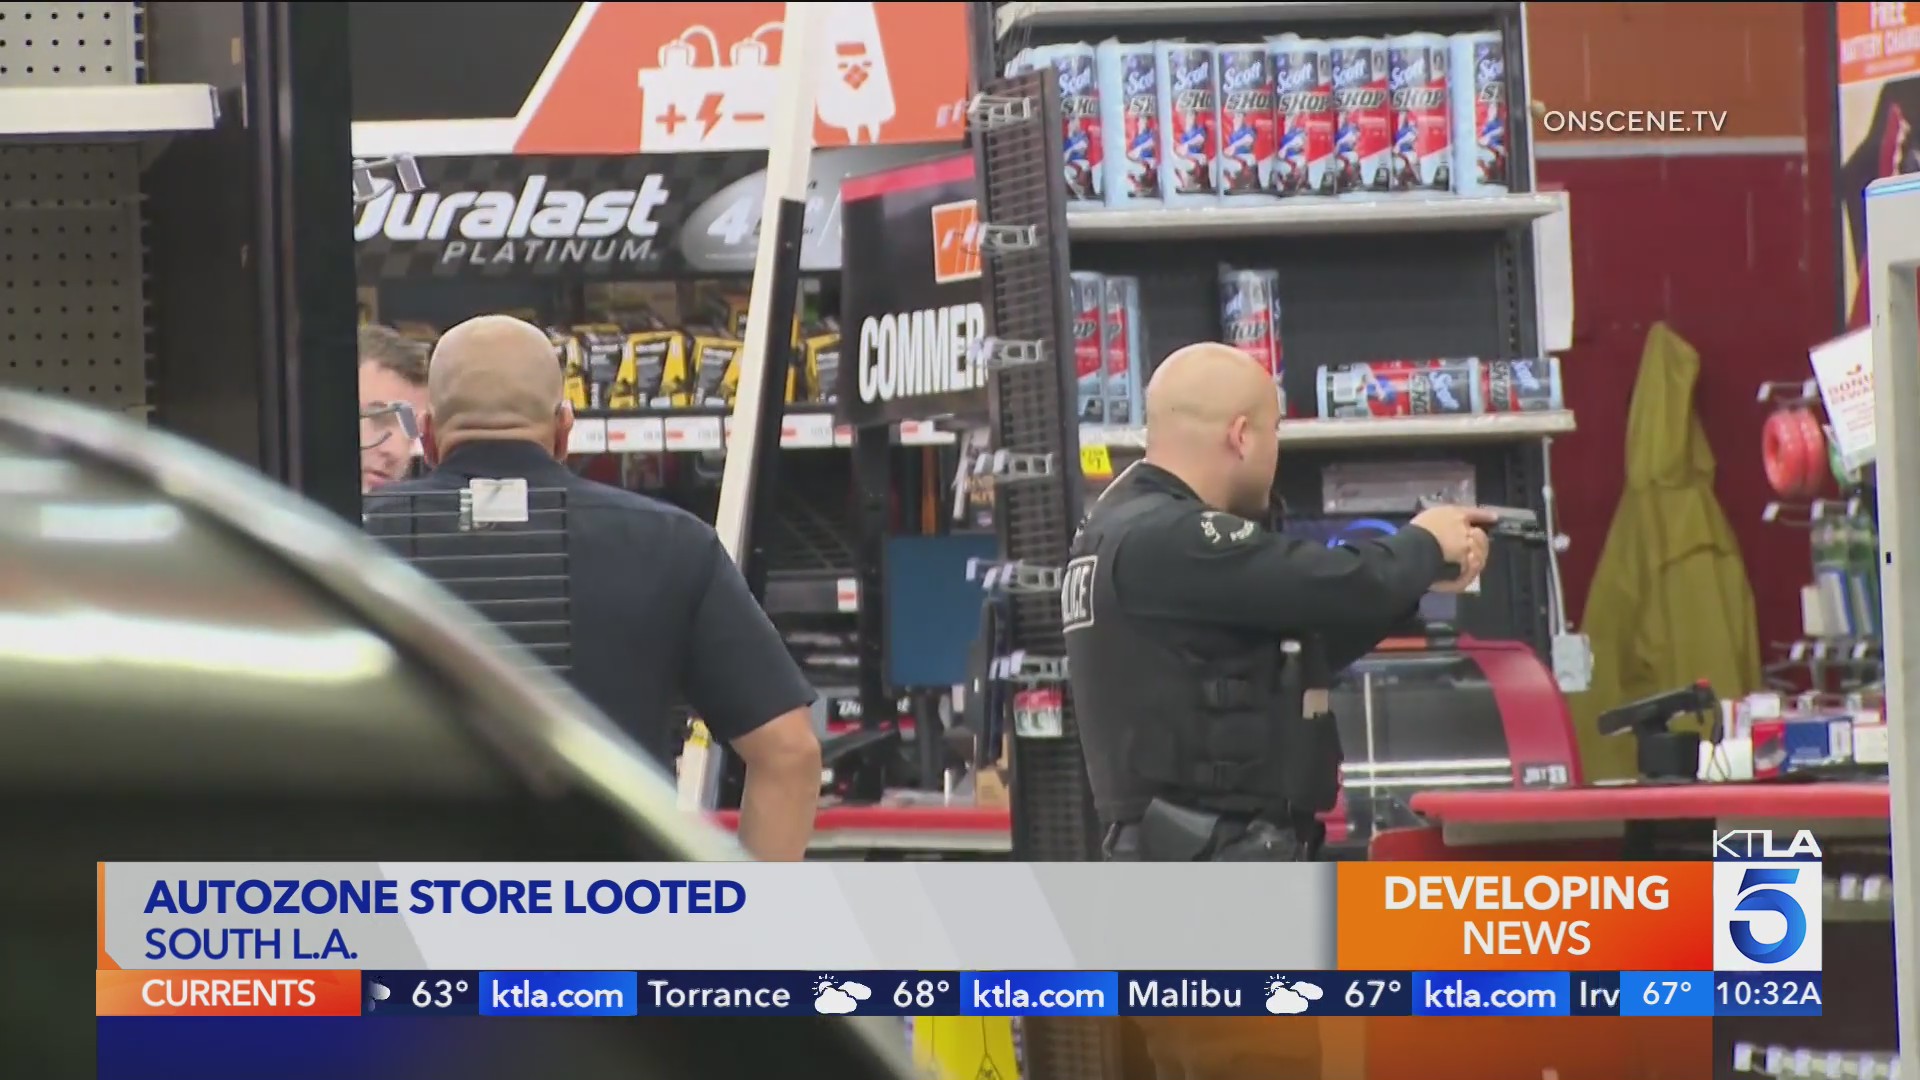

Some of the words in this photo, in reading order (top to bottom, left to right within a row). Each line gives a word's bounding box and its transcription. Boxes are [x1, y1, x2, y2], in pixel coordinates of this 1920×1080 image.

[1223, 60, 1262, 95] Scott
[1333, 88, 1388, 109] SHOP
[353, 174, 669, 242] Duralast
[1062, 564, 1090, 624] LICE
